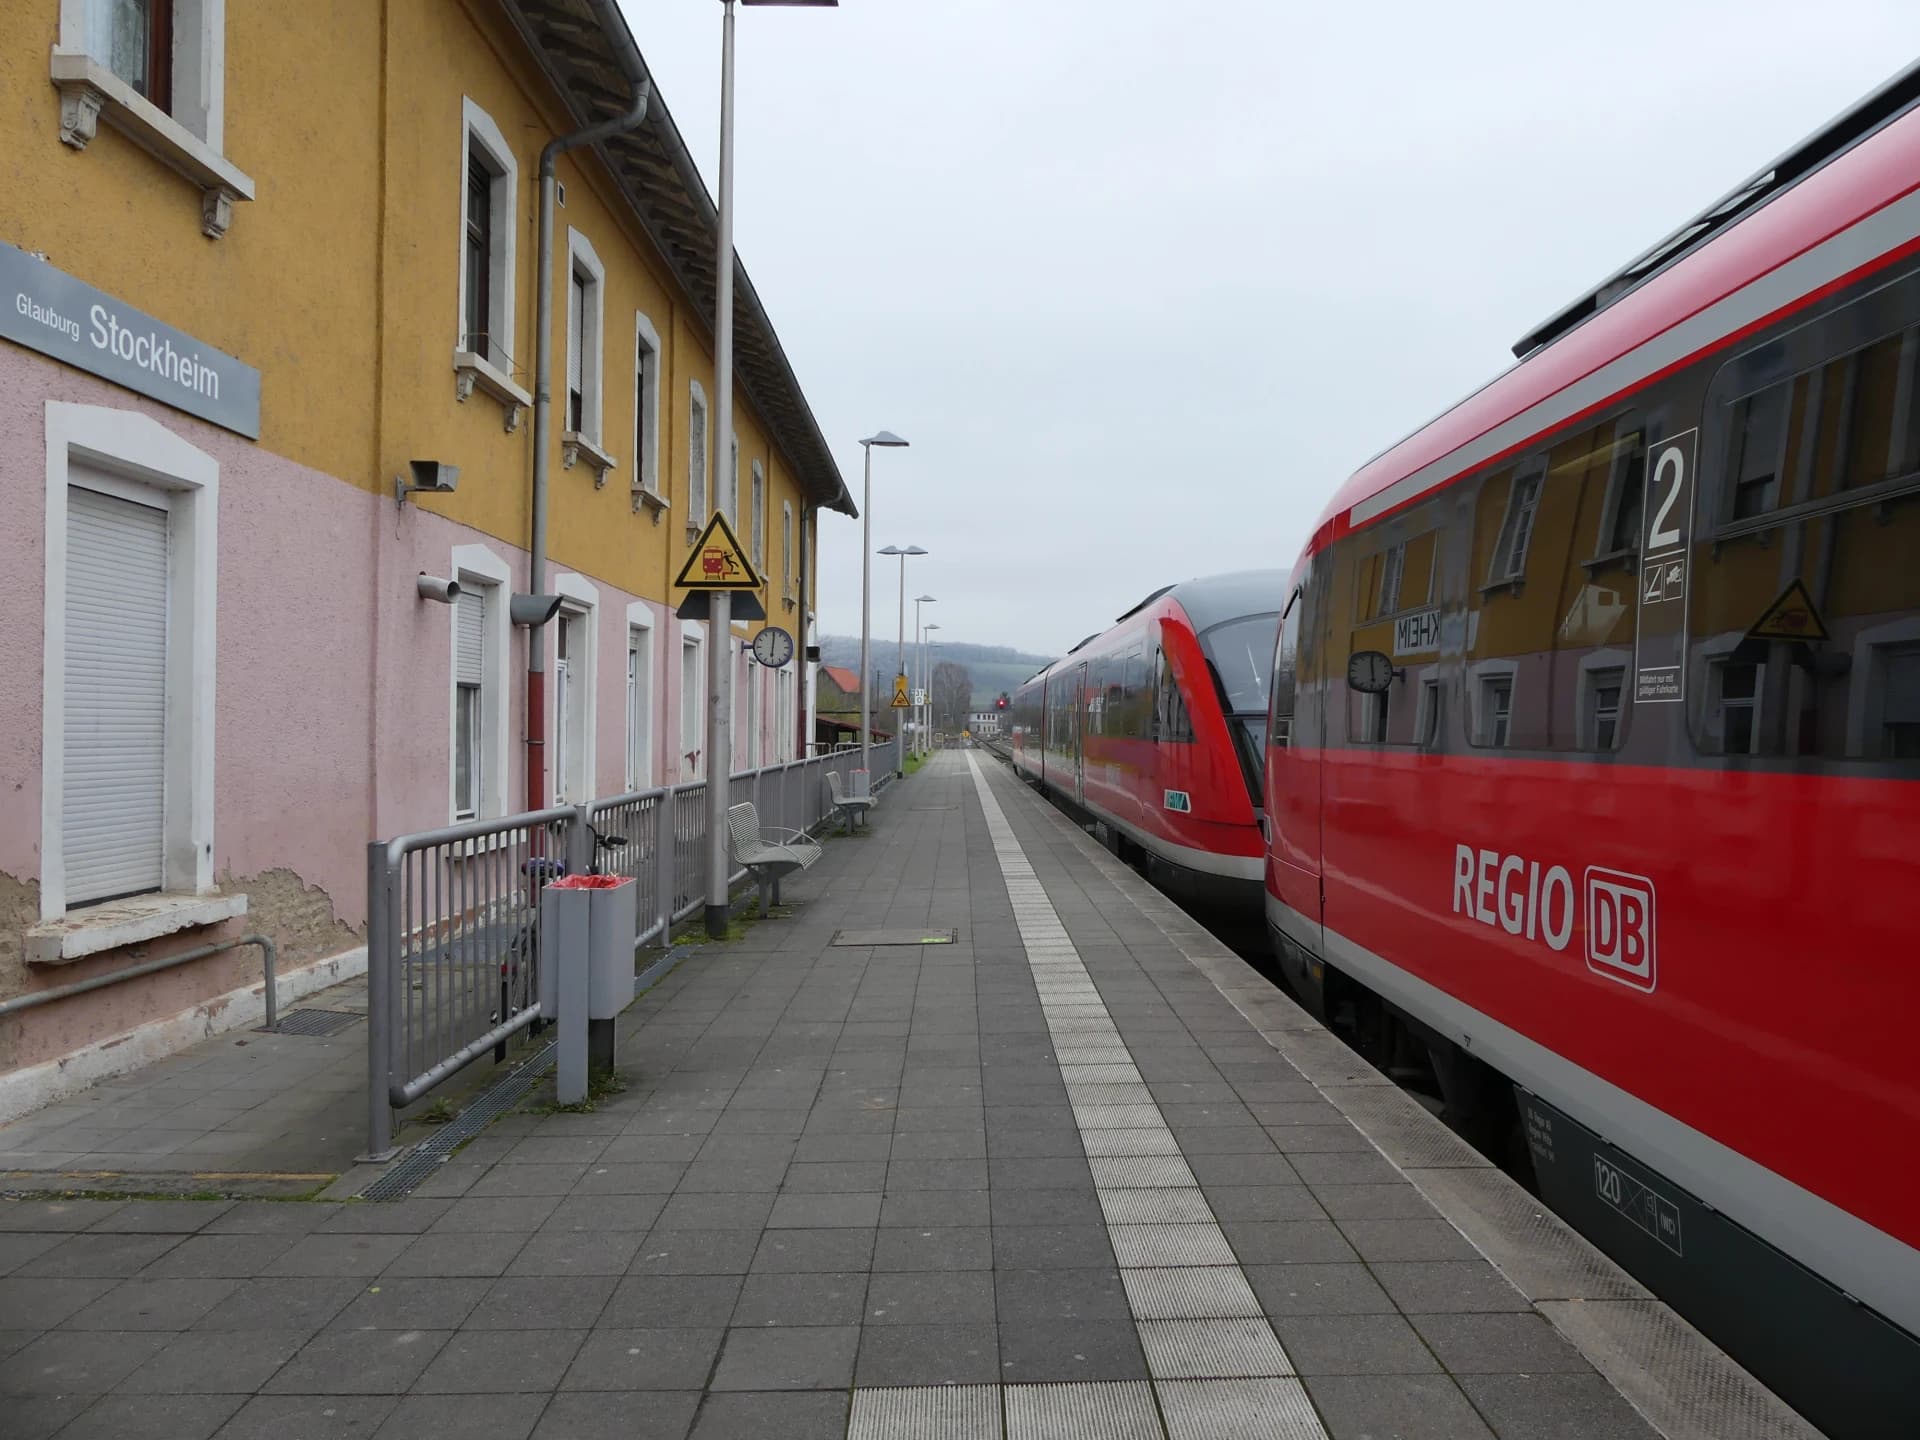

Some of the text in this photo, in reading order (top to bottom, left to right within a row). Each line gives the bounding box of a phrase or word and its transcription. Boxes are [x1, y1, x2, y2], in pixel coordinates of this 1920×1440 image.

[16, 293, 219, 400] Glauburg Stockheim
[1648, 446, 1684, 550] 2
[1453, 843, 1647, 970] REGIO DB
[1596, 1160, 1620, 1205] 120
